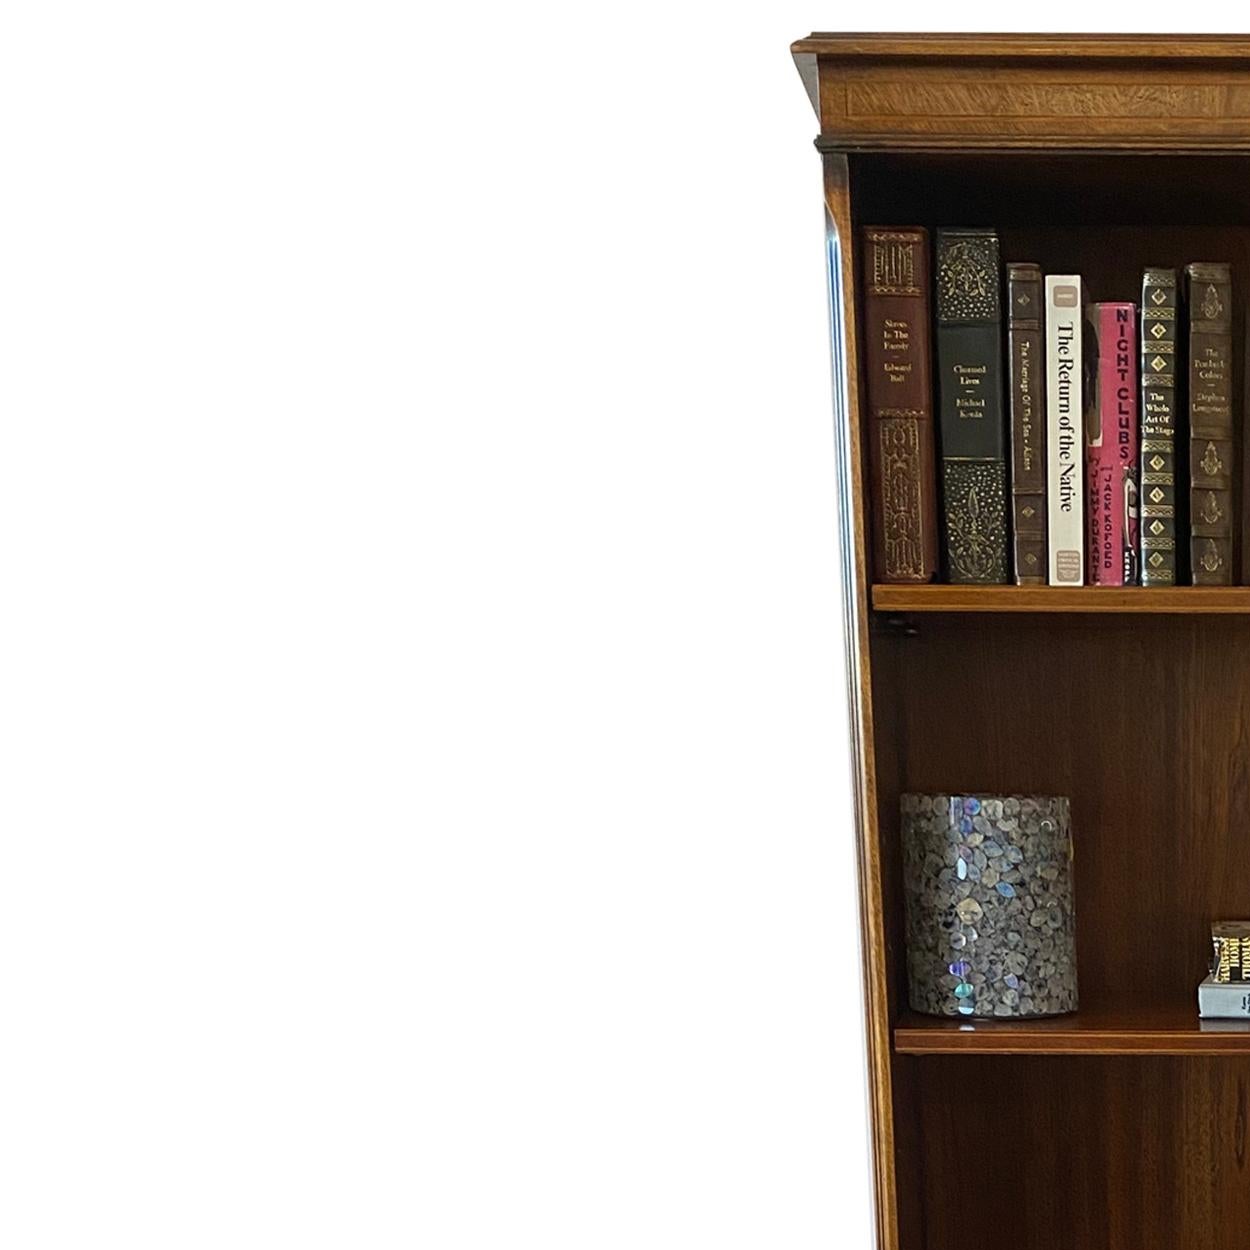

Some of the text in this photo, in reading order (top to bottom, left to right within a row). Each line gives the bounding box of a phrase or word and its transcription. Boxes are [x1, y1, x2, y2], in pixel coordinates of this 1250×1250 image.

[1057, 321, 1076, 512] The Return of the Native
[1116, 308, 1130, 460] NIGHT CLUBS
[1104, 473, 1113, 569] JACK KOFOED
